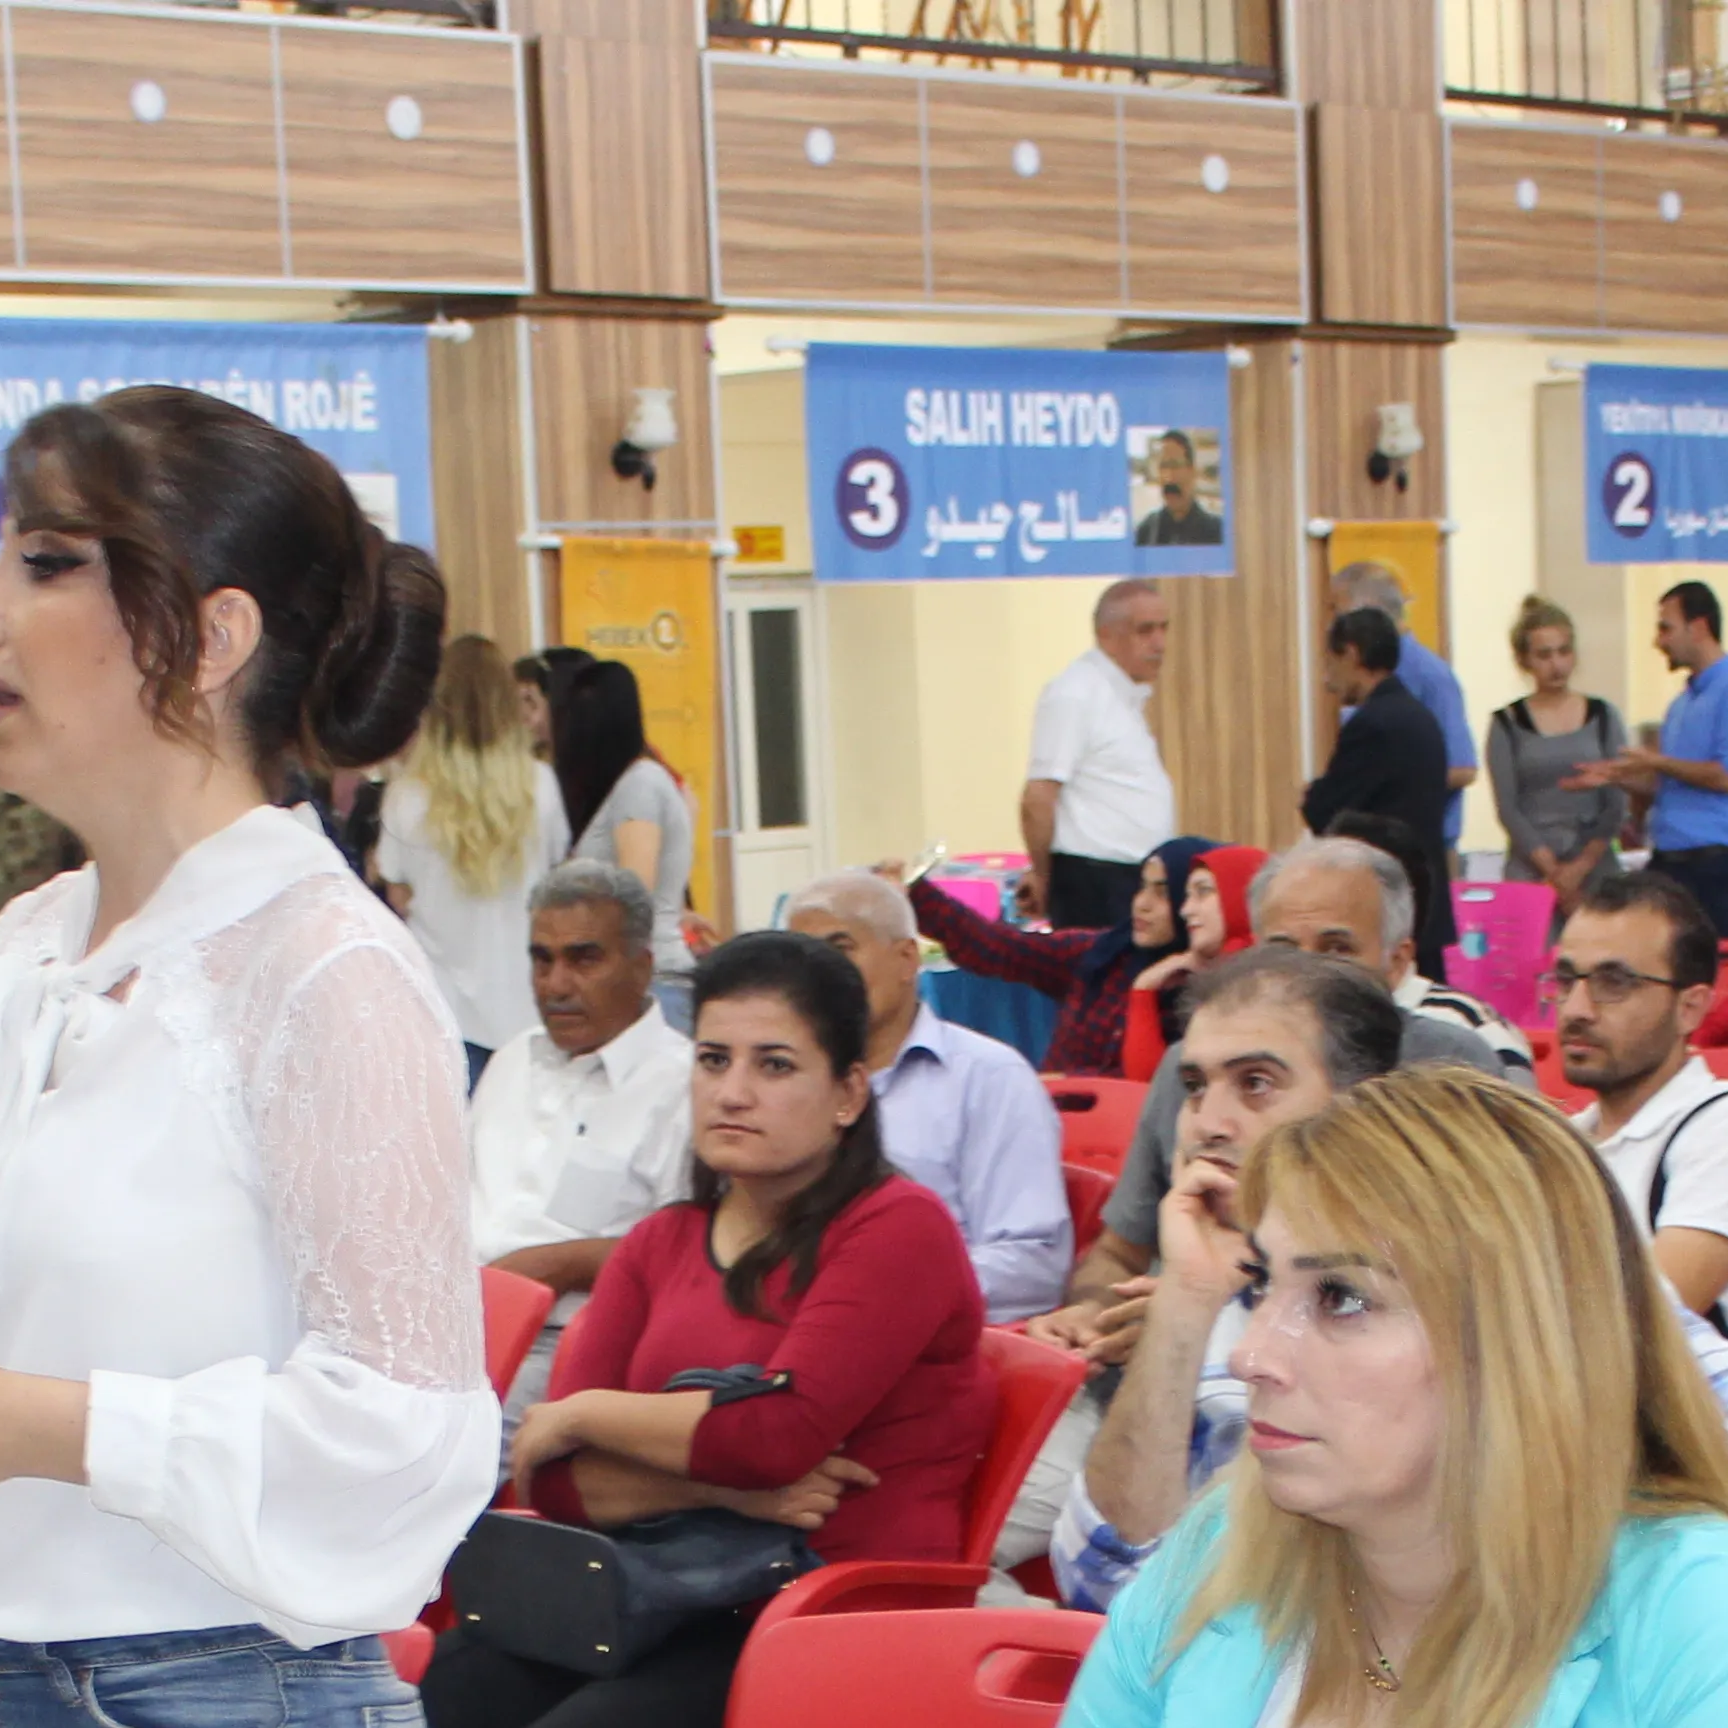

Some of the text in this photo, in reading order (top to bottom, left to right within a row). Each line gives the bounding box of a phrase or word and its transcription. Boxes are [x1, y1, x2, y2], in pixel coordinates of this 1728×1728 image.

[282, 369, 380, 431] ROJÊ
[905, 390, 1120, 448] SALIH HEYDO
[848, 460, 900, 537] 3
[1018, 490, 1127, 562] صالح
[1613, 460, 1651, 528] 2
